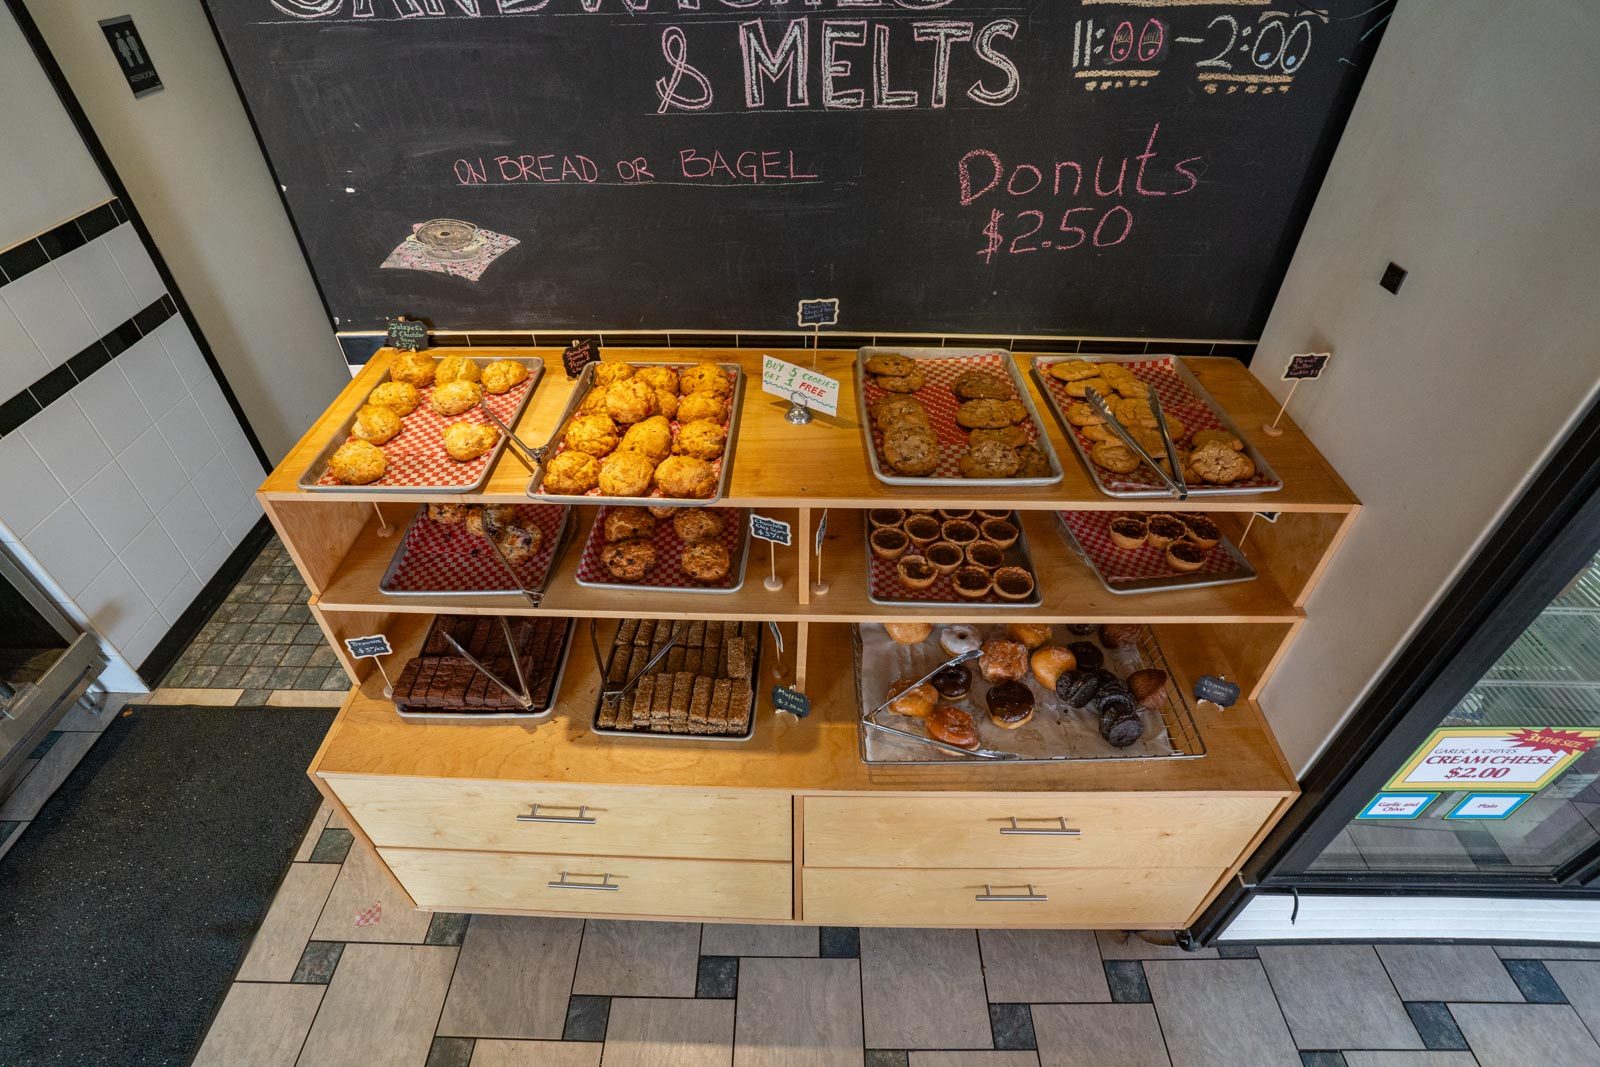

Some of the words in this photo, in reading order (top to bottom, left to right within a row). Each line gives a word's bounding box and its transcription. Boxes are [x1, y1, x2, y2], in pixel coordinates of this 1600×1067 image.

[656, 26, 713, 113] &
[739, 16, 1020, 109] MELTS
[454, 157, 487, 184] ON
[494, 154, 599, 183] BREAD
[616, 156, 655, 182] OR
[680, 149, 818, 183] BAGEL
[958, 121, 1201, 206] Donuts
[976, 205, 1133, 264] $2.50
[764, 370, 781, 382] GET
[784, 378, 794, 387] 1
[798, 381, 826, 398] FREE
[765, 359, 785, 372] BUY
[789, 367, 800, 378] 5
[802, 373, 838, 390] COOKIES
[1542, 736, 1560, 745] THE
[1562, 740, 1585, 748] SIZE
[1426, 755, 1494, 765] CREAM
[1491, 755, 1557, 765] CHEESE
[1444, 766, 1511, 779] $2.00
